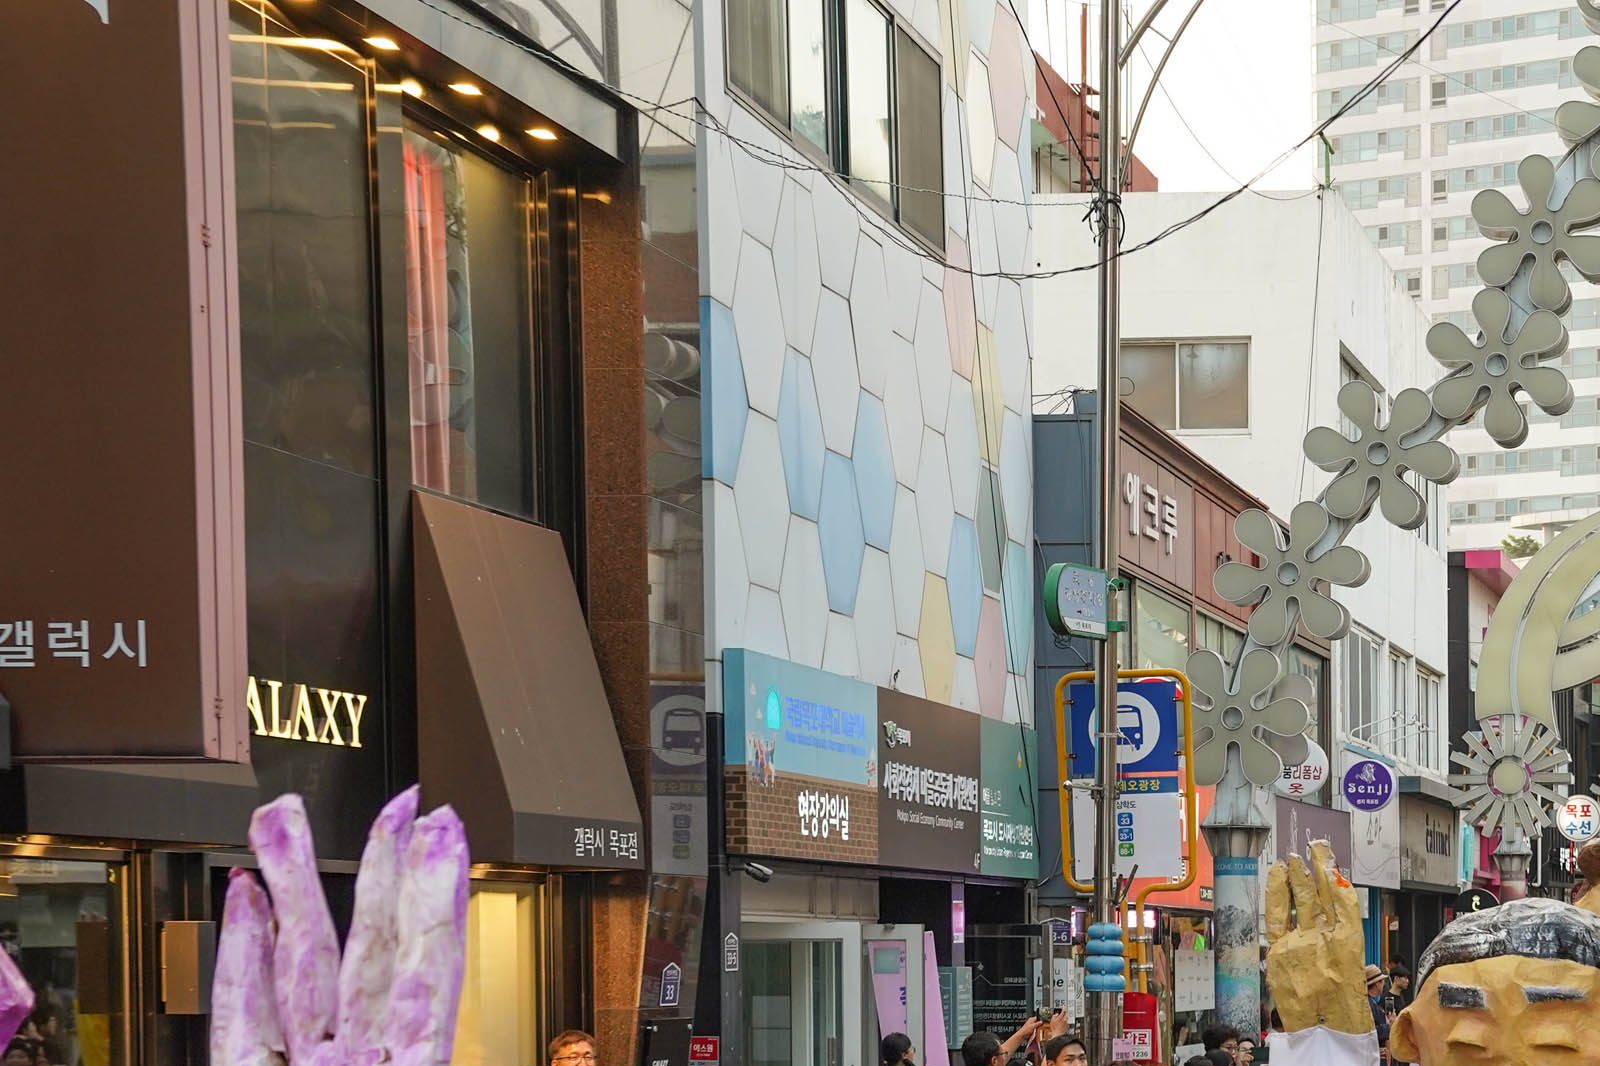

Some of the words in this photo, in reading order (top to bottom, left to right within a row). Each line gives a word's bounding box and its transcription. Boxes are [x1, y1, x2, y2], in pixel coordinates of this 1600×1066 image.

[1123, 470, 1178, 556] 에크루
[0, 620, 148, 667] 갤럭시
[246, 675, 367, 748] ALAXY
[1117, 779, 1161, 792] 데오광장
[1288, 782, 1305, 794] 옷
[798, 789, 850, 841] 현장강의실
[909, 811, 920, 824] Social
[1566, 804, 1592, 818] 목포
[1120, 817, 1130, 825] 33
[1565, 821, 1592, 836] 수선
[574, 827, 605, 857] 갤럭시
[609, 830, 638, 860] 목포점
[1051, 931, 1068, 942] 3-6
[665, 985, 675, 1000] 33
